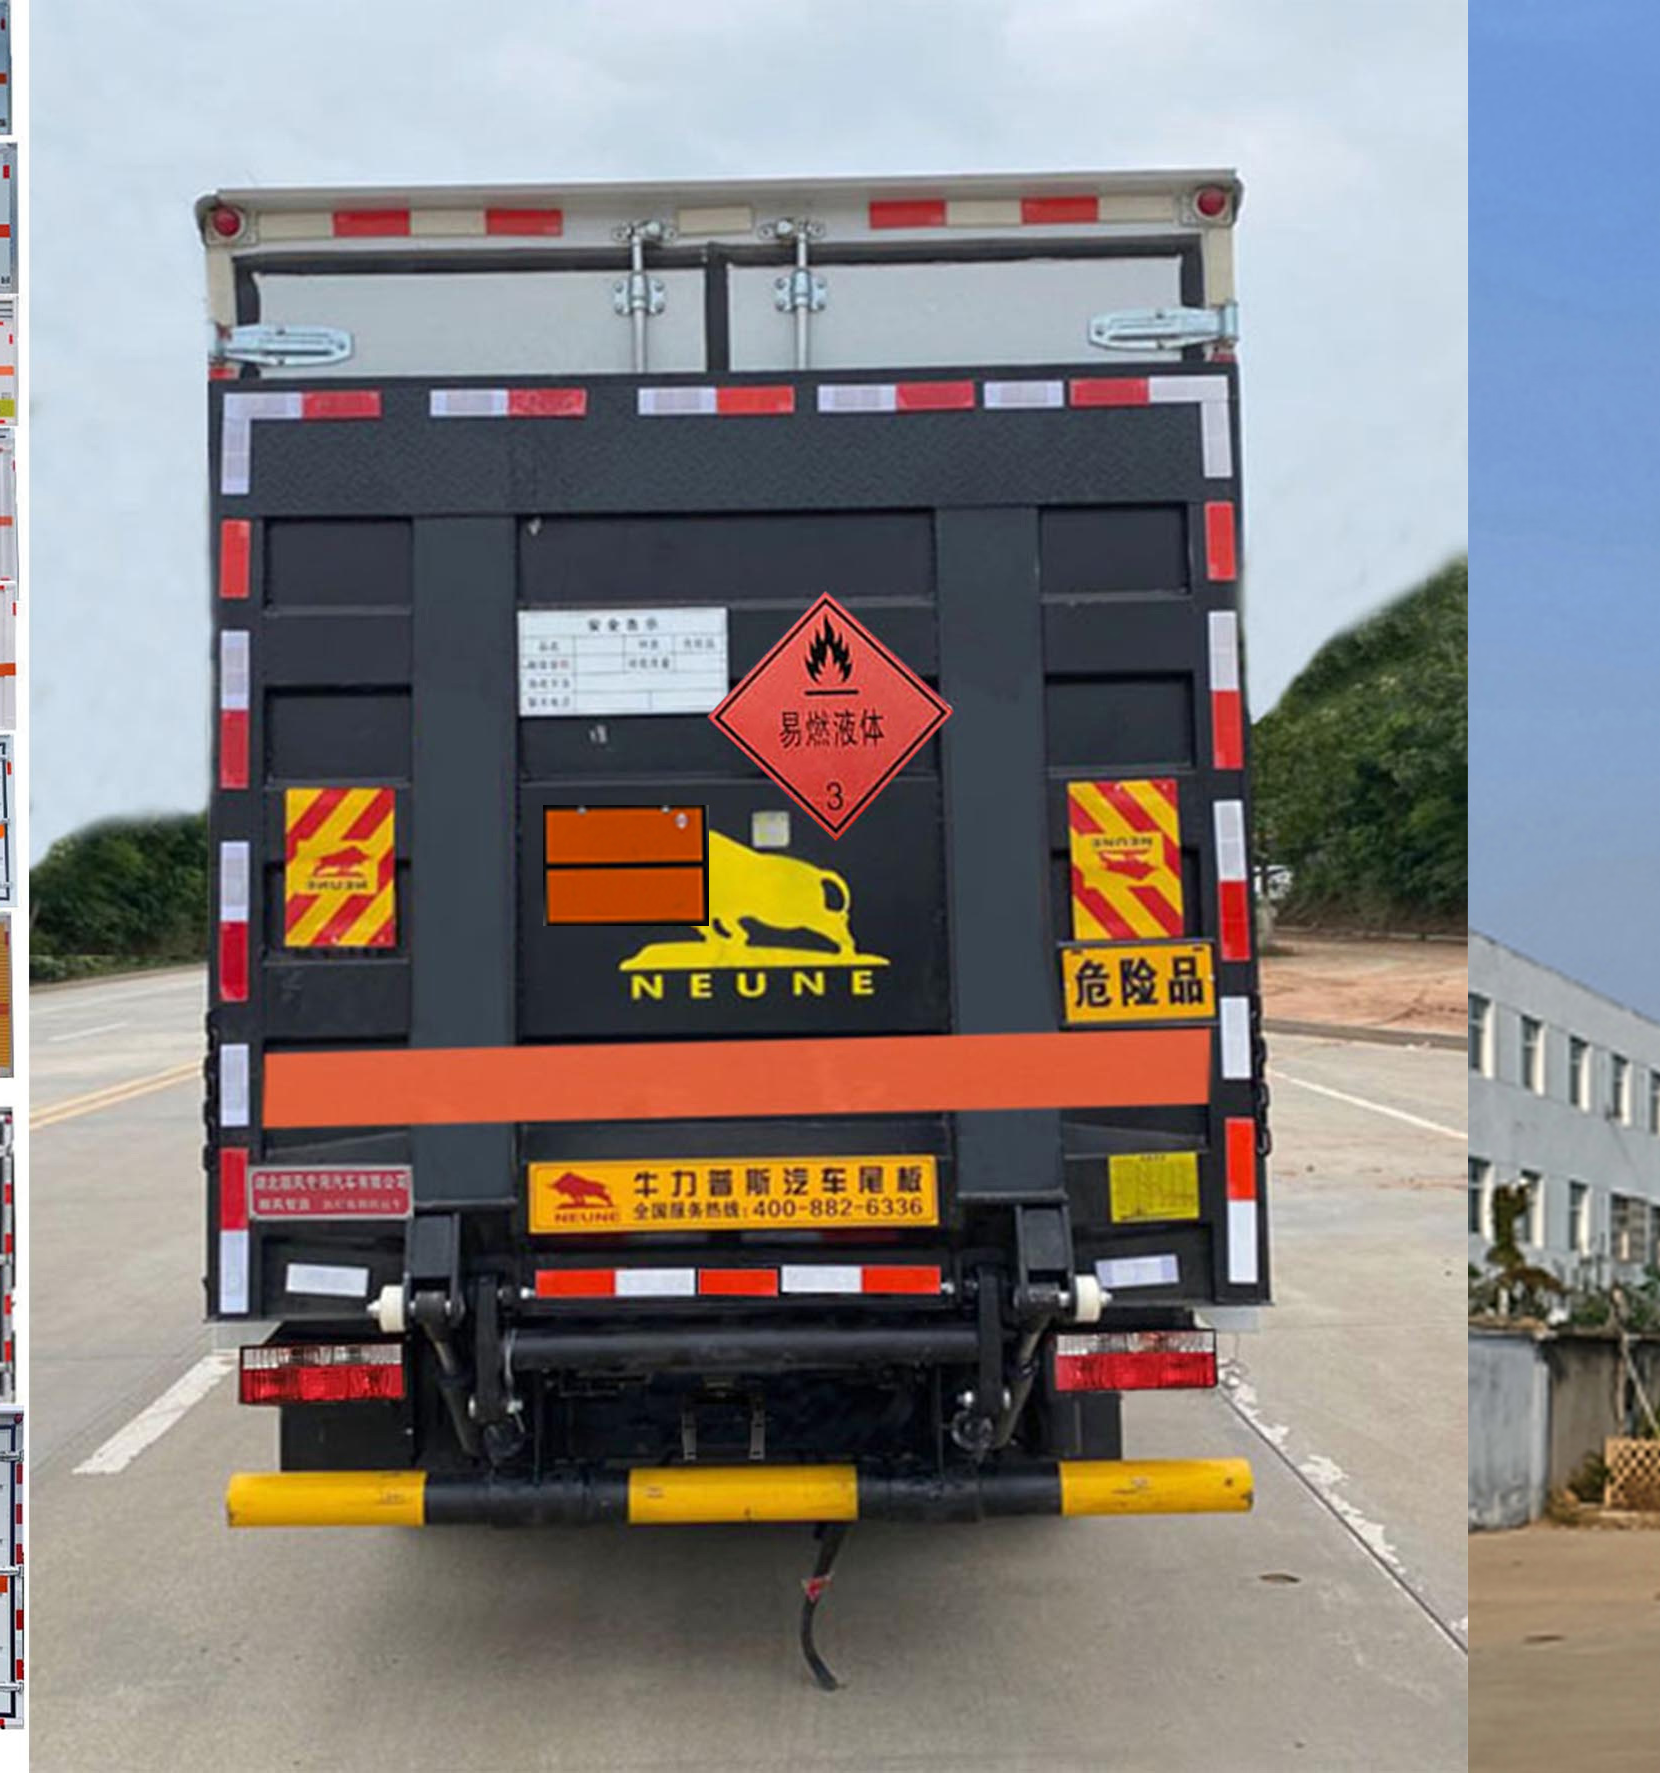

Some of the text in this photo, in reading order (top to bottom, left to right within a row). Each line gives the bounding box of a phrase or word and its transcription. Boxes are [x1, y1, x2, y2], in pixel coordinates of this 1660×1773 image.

[780, 710, 885, 747] 易燃液体
[826, 781, 844, 811] 3
[630, 969, 876, 1000] NEUNE
[1075, 956, 1204, 1008] 危险品
